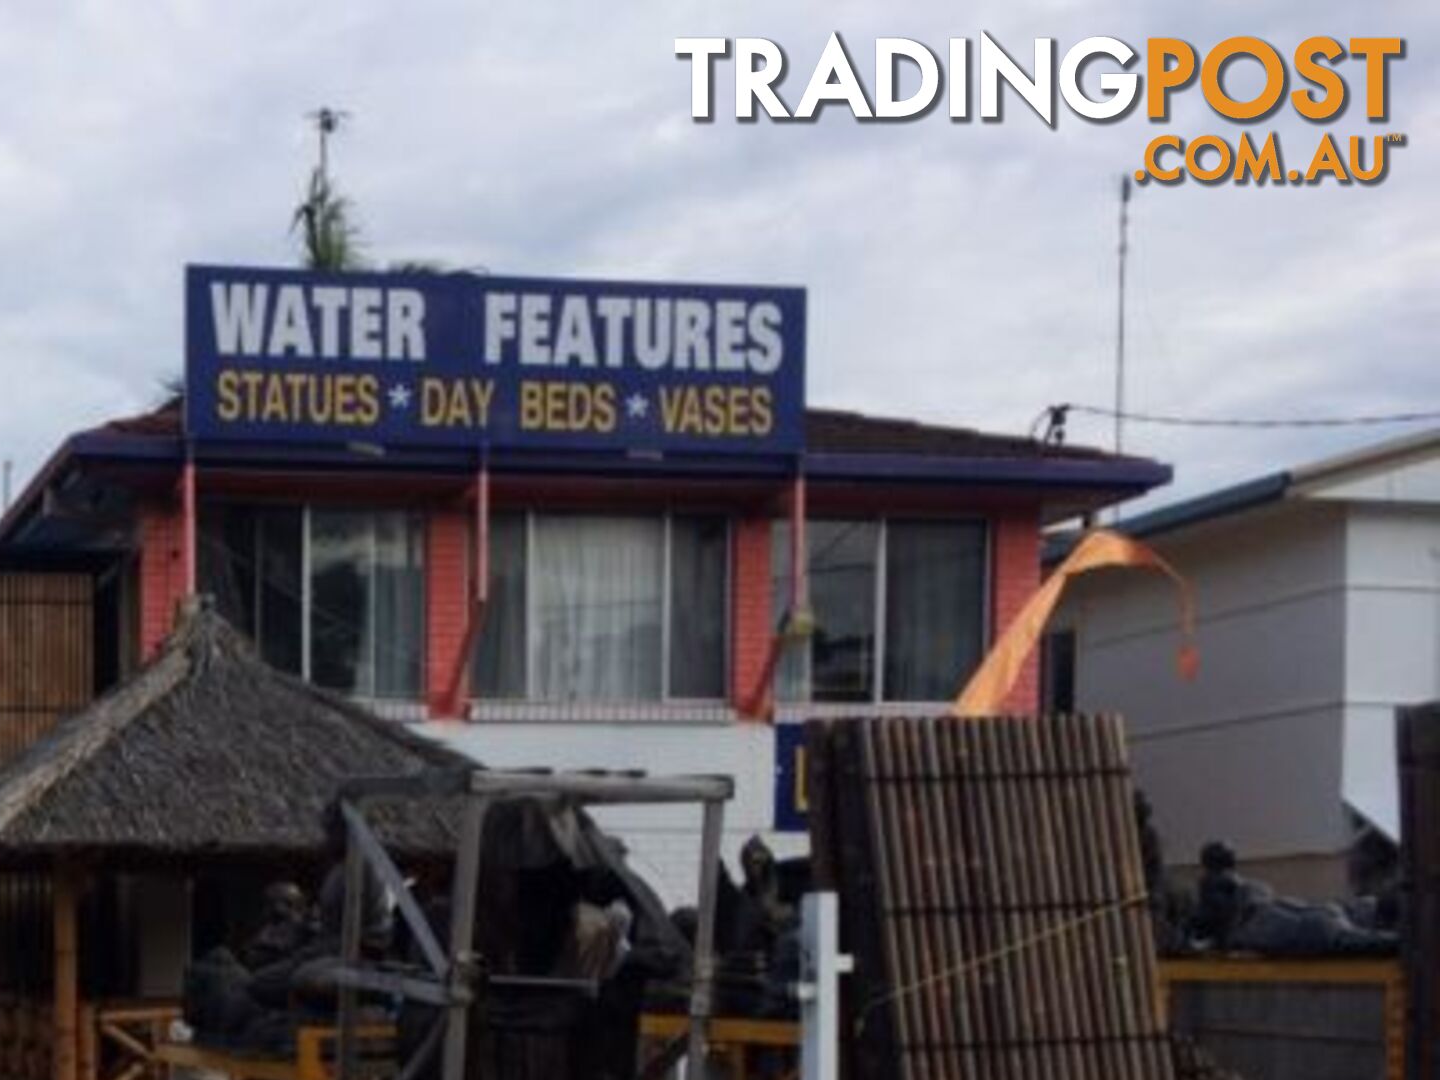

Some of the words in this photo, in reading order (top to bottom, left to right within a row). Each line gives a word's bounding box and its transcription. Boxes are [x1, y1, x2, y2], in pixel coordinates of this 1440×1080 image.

[210, 282, 426, 361] WATER
[483, 292, 784, 374] FEATURES
[217, 370, 380, 425] STATUES
[421, 376, 494, 429] DAY
[520, 379, 617, 432] BEDS
[660, 386, 773, 435] VASES
